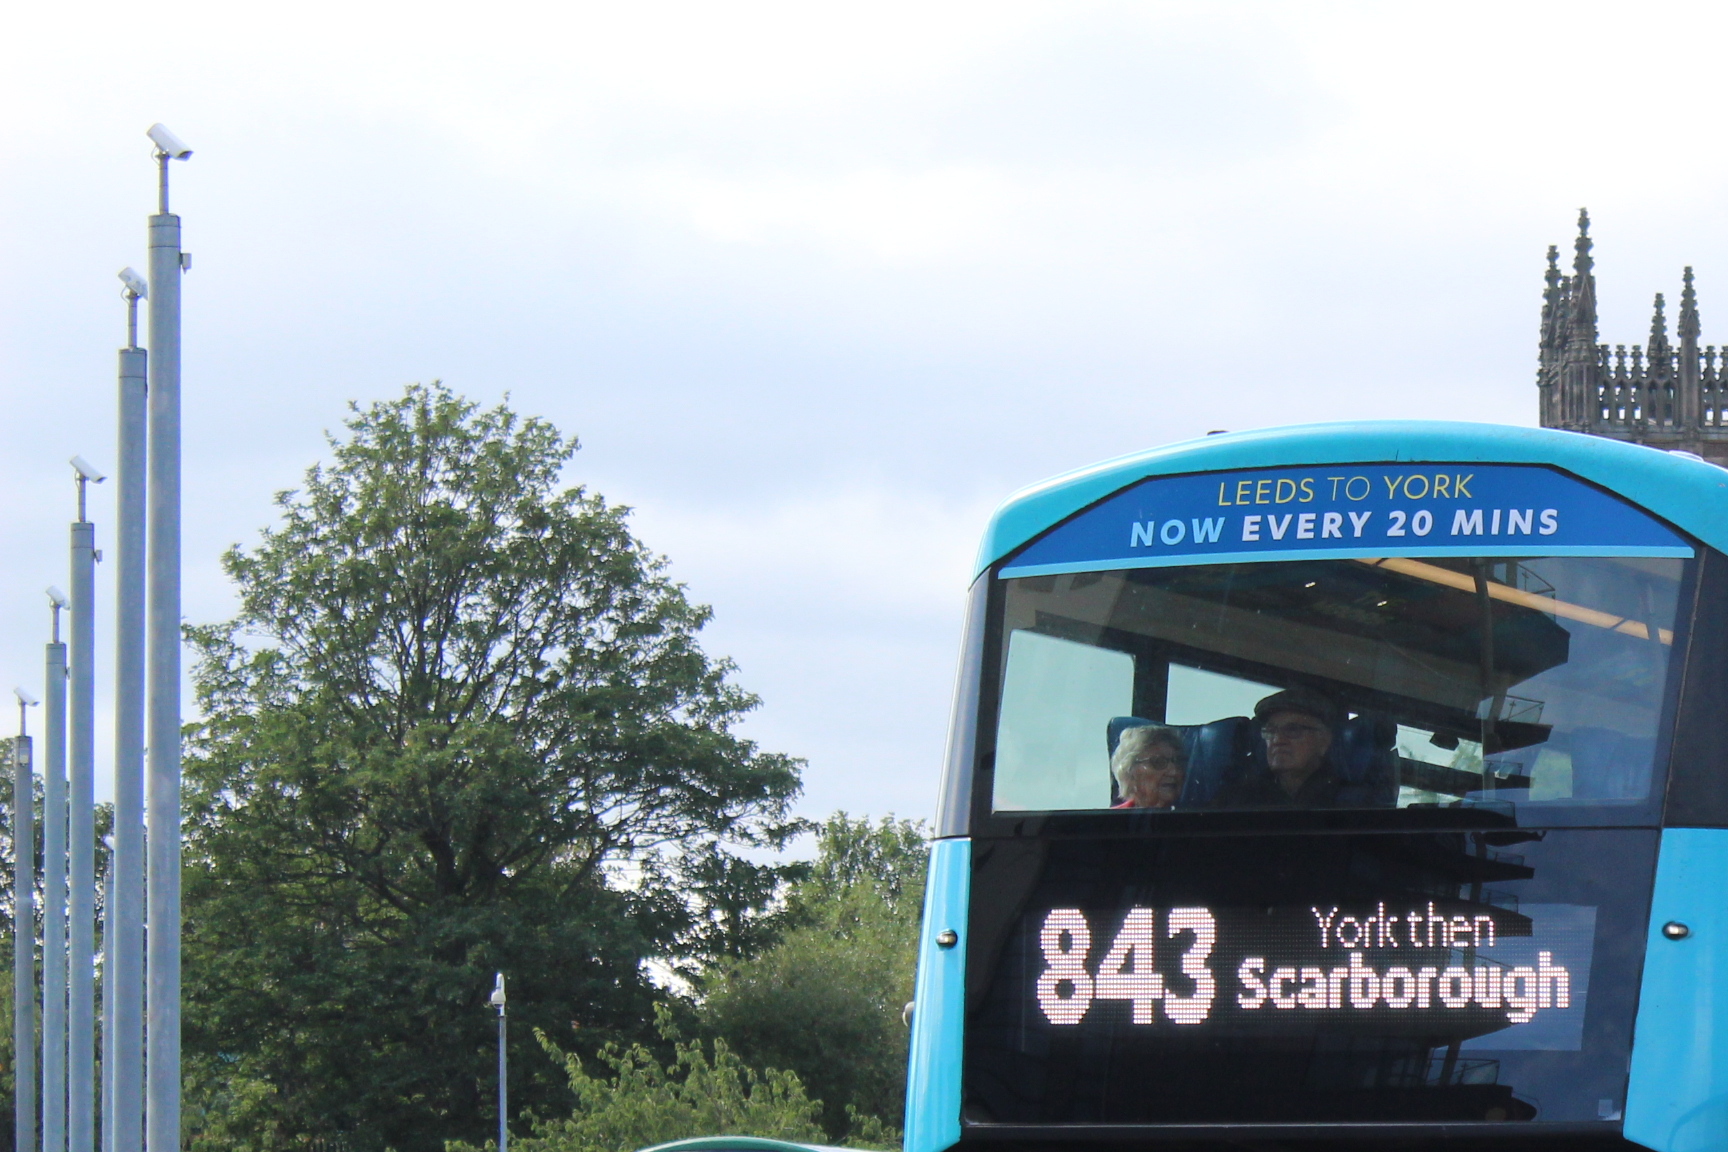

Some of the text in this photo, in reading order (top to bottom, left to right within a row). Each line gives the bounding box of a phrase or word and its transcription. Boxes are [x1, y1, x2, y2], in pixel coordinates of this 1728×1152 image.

[1218, 473, 1475, 507] LEEDS TO YORK
[1129, 508, 1560, 548] NOW EVERY 20 MINS
[1311, 901, 1497, 949] York then
[1036, 906, 1217, 1026] 843
[1236, 951, 1571, 1025] Scarborough
